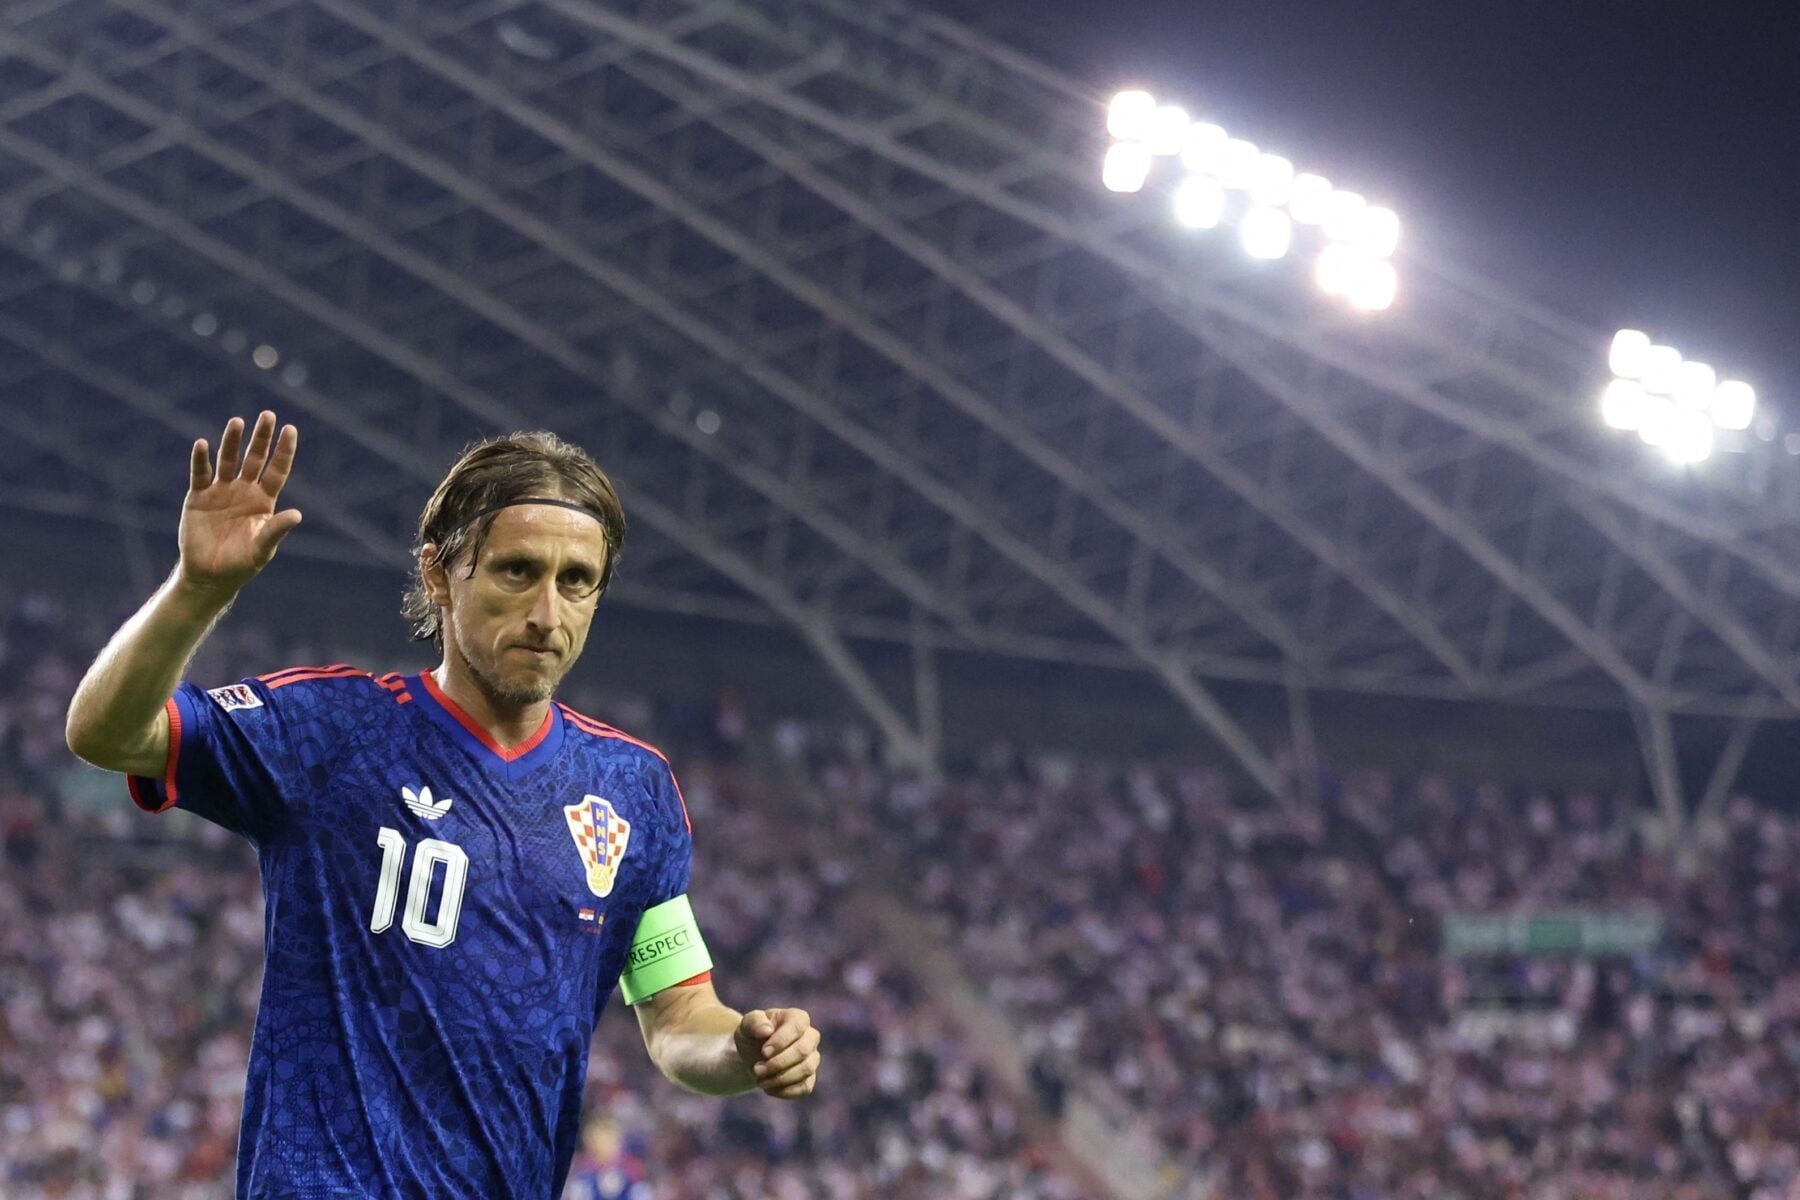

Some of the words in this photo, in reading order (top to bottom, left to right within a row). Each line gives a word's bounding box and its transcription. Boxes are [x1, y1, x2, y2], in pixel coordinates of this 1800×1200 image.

[596, 808, 605, 855] HNS
[370, 826, 469, 949] 10
[629, 929, 690, 966] RESPECT
